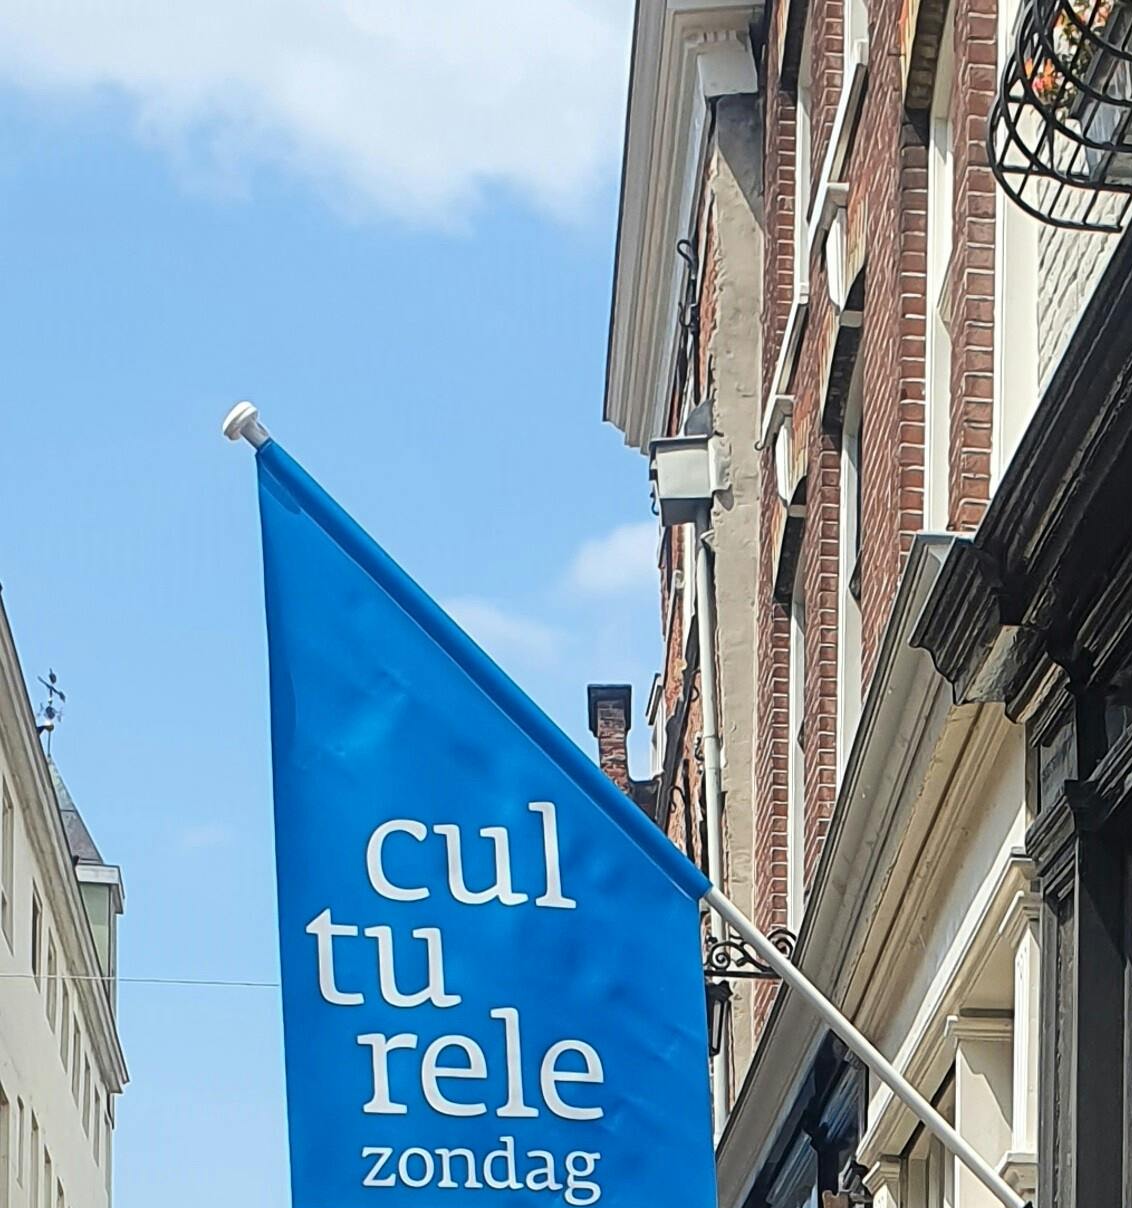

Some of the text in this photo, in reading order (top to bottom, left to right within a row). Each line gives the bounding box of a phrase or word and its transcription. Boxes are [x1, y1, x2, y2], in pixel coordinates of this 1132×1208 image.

[365, 801, 577, 909] cul
[305, 908, 461, 1008] tu
[357, 1007, 605, 1120] rele
[361, 1136, 602, 1206] zondag
